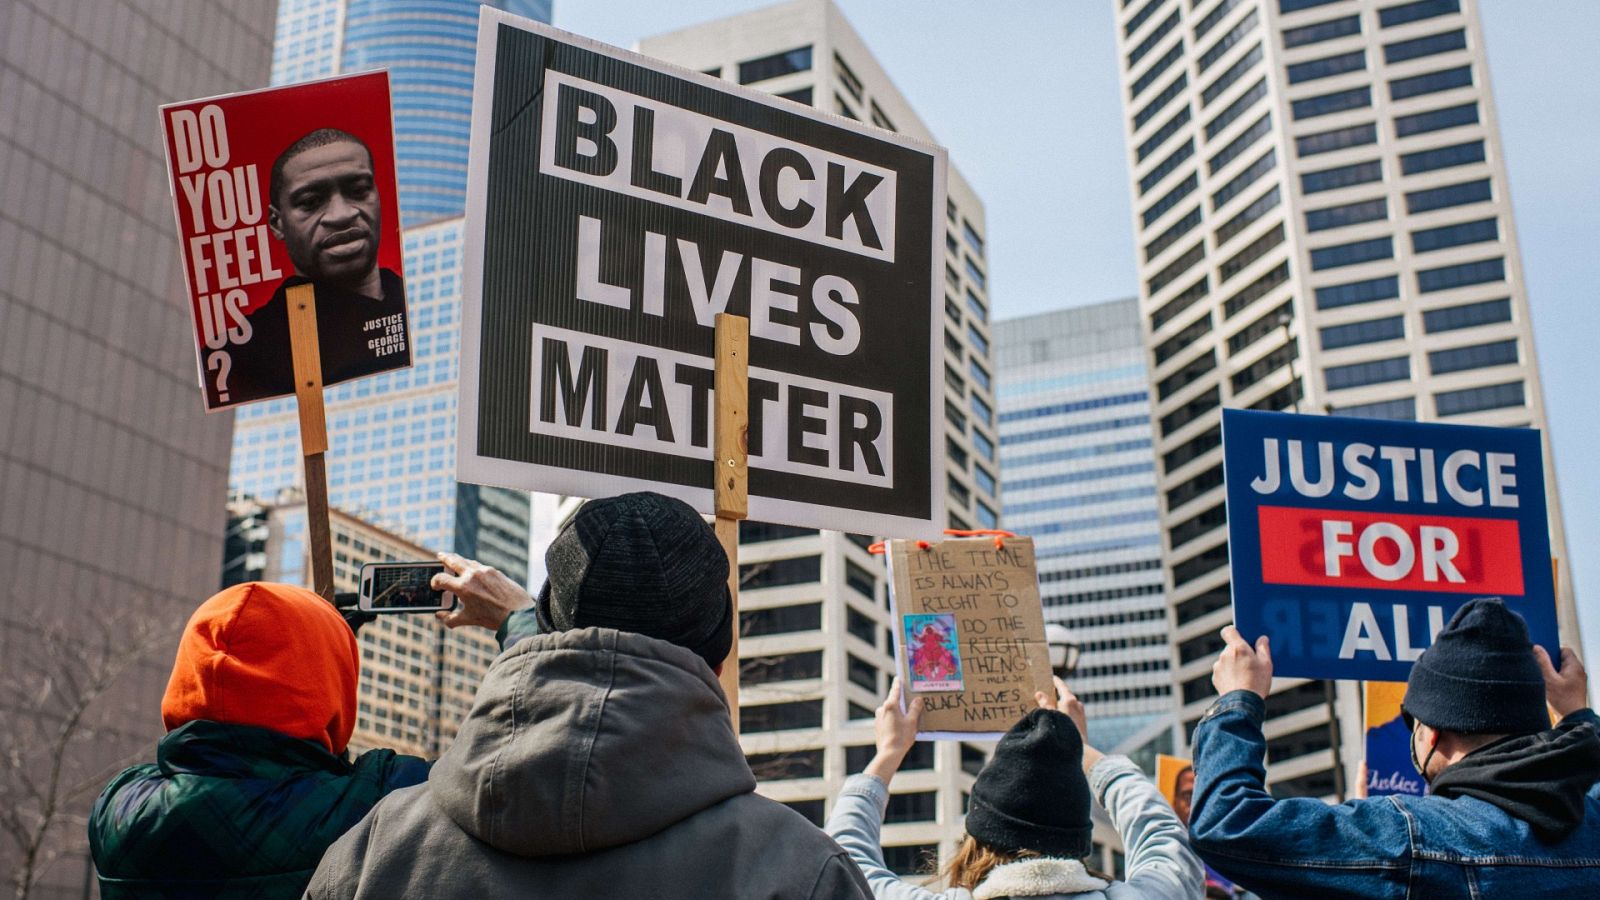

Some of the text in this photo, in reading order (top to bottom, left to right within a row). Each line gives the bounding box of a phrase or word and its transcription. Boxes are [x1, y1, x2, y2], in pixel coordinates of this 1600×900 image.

[170, 104, 230, 174] DO
[554, 82, 884, 252] BLACK
[179, 164, 263, 233] YOU
[189, 225, 283, 294] FEEL
[576, 214, 862, 356] LIVES
[198, 288, 253, 350] US
[362, 312, 403, 332] JUSTICE
[385, 322, 404, 336] FOR
[367, 332, 405, 350] GEORGE
[375, 341, 406, 357] FLOYD
[207, 350, 233, 403] ?
[539, 336, 885, 477] MATTER
[1250, 438, 1520, 508] JUSTICE
[915, 546, 1029, 570] THE TIME
[1321, 519, 1466, 584] FOR
[914, 571, 1009, 591] IS ALWAYS
[921, 593, 1019, 613] RIGHT TO
[962, 616, 1026, 635] DO THE
[968, 637, 1029, 660] RIGHT
[961, 656, 1027, 673] THING
[923, 688, 1021, 712] BLACK LIVES
[963, 703, 1028, 721] MATTER
